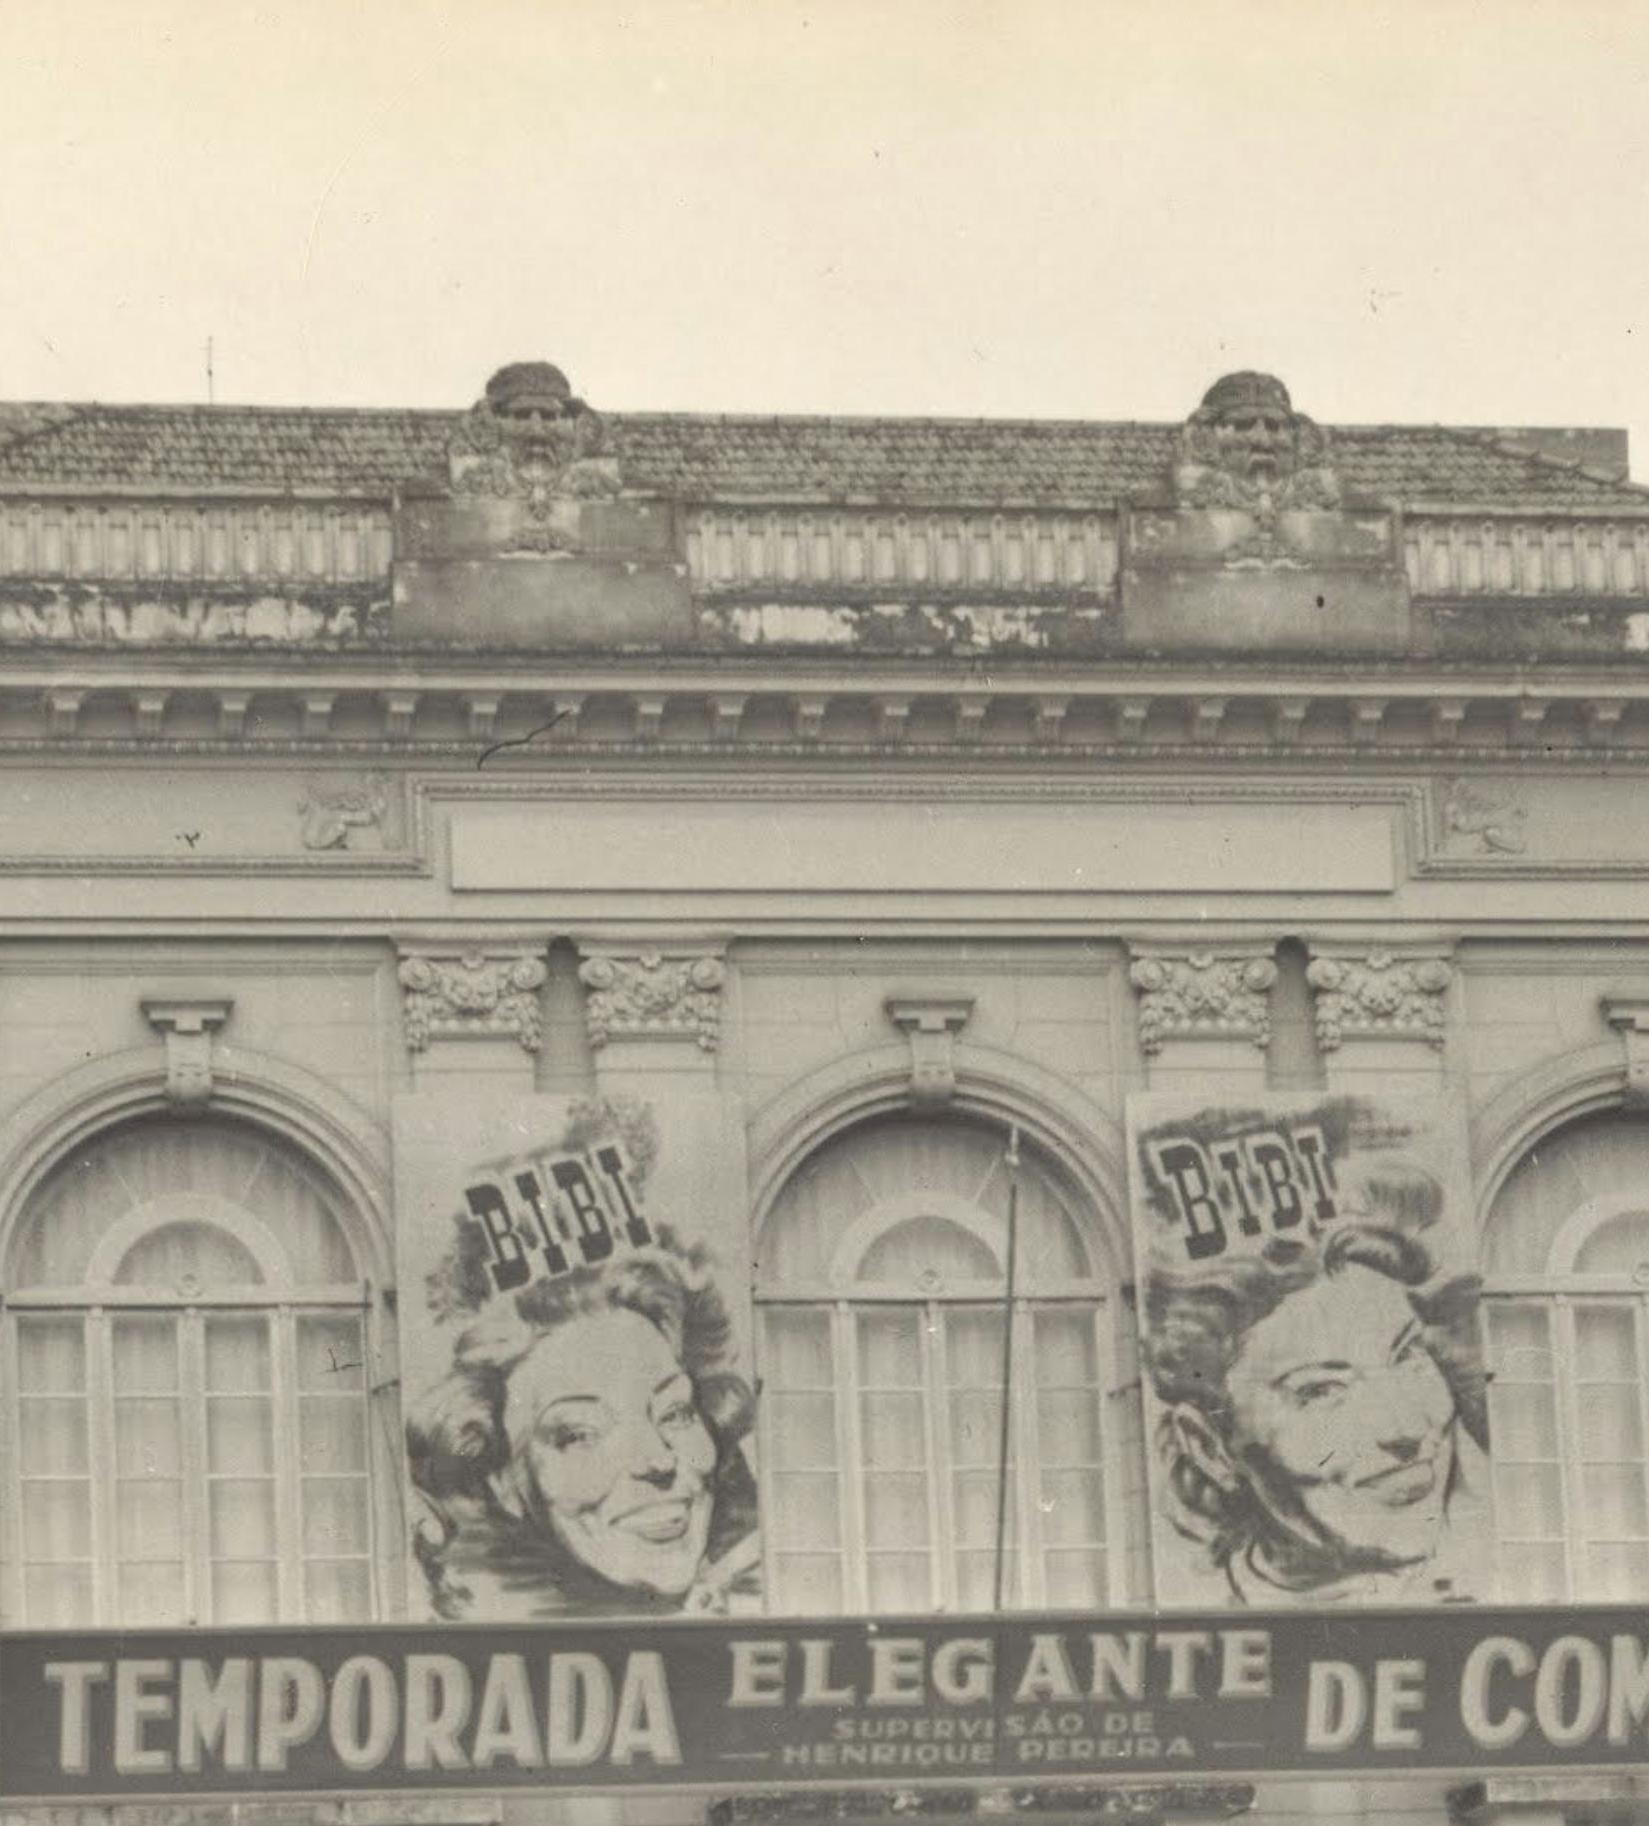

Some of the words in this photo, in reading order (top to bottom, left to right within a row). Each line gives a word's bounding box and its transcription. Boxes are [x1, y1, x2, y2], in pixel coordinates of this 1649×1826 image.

[465, 1146, 651, 1292] BIBI
[1159, 1136, 1336, 1260] BIBI
[45, 1652, 682, 1775] TEMPORADA
[727, 1629, 1273, 1709] ELEGANTE
[1305, 1658, 1426, 1752] DE
[783, 1742, 995, 1766] HENRIQUE
[1019, 1736, 1195, 1761] PEREIRA
[1105, 1710, 1153, 1734] DE
